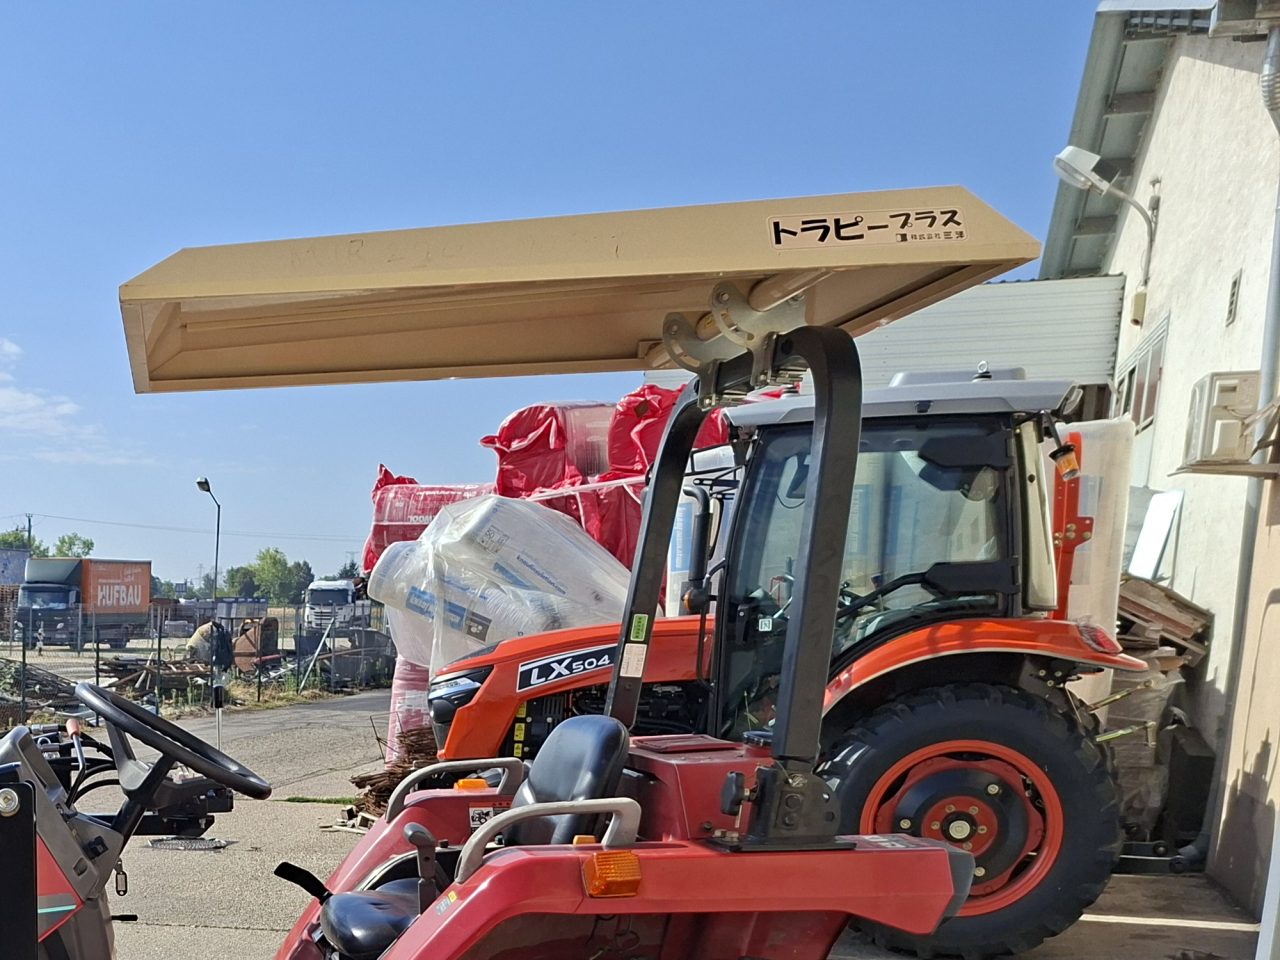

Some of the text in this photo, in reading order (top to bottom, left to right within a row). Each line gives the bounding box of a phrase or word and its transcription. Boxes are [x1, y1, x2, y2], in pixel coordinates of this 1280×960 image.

[773, 209, 962, 245] トラピープラス
[531, 654, 611, 685] LX504
